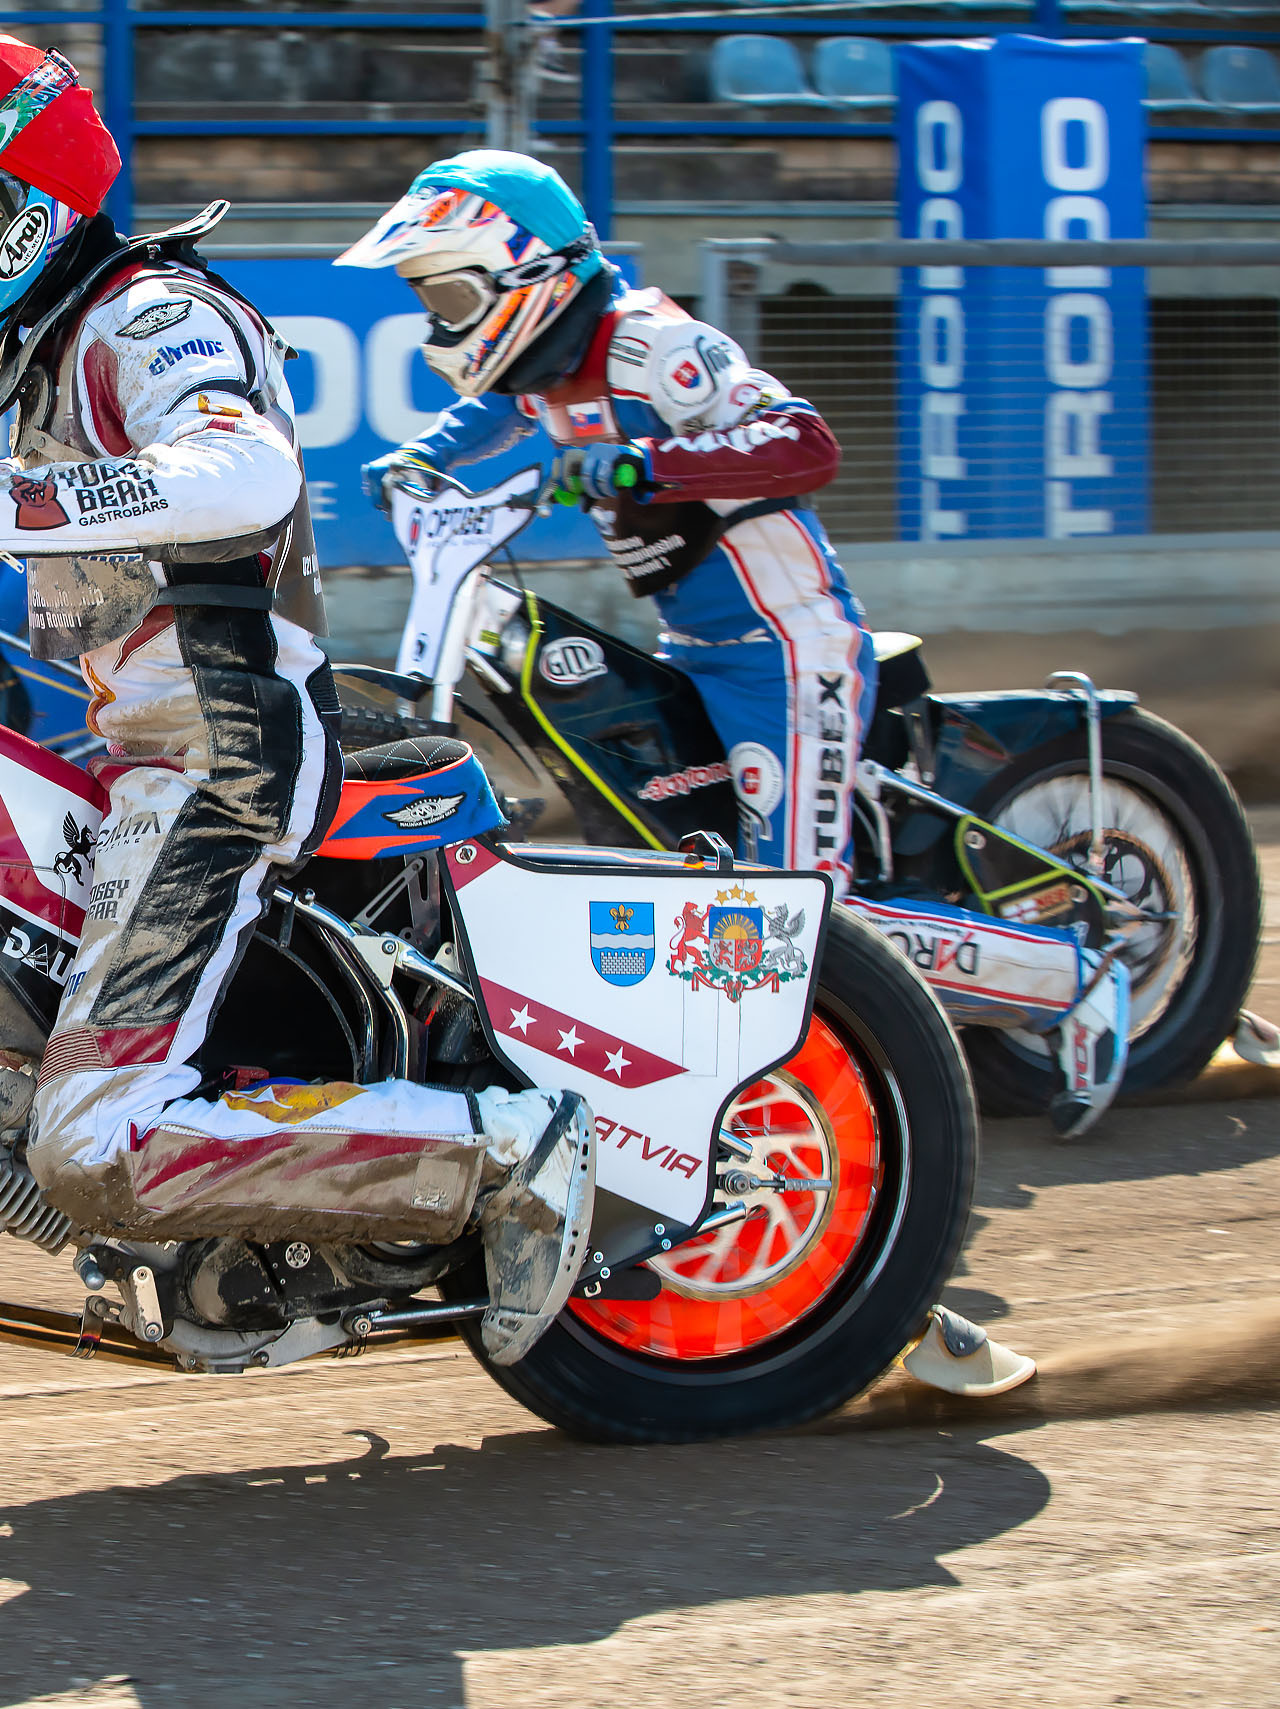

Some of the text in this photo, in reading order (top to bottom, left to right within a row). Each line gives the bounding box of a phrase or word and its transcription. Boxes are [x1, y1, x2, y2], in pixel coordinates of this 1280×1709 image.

[4, 211, 42, 277] Arai
[916, 100, 966, 541] TRODO
[1041, 97, 1113, 538] TRODO
[75, 478, 159, 514] BEAR
[78, 499, 169, 527] GASTROBĀRS
[46, 611, 74, 628] Round
[814, 673, 846, 857] TUBEX
[87, 901, 118, 921] EAR
[91, 880, 129, 904] OGGY
[594, 1116, 703, 1179] ATVIA
